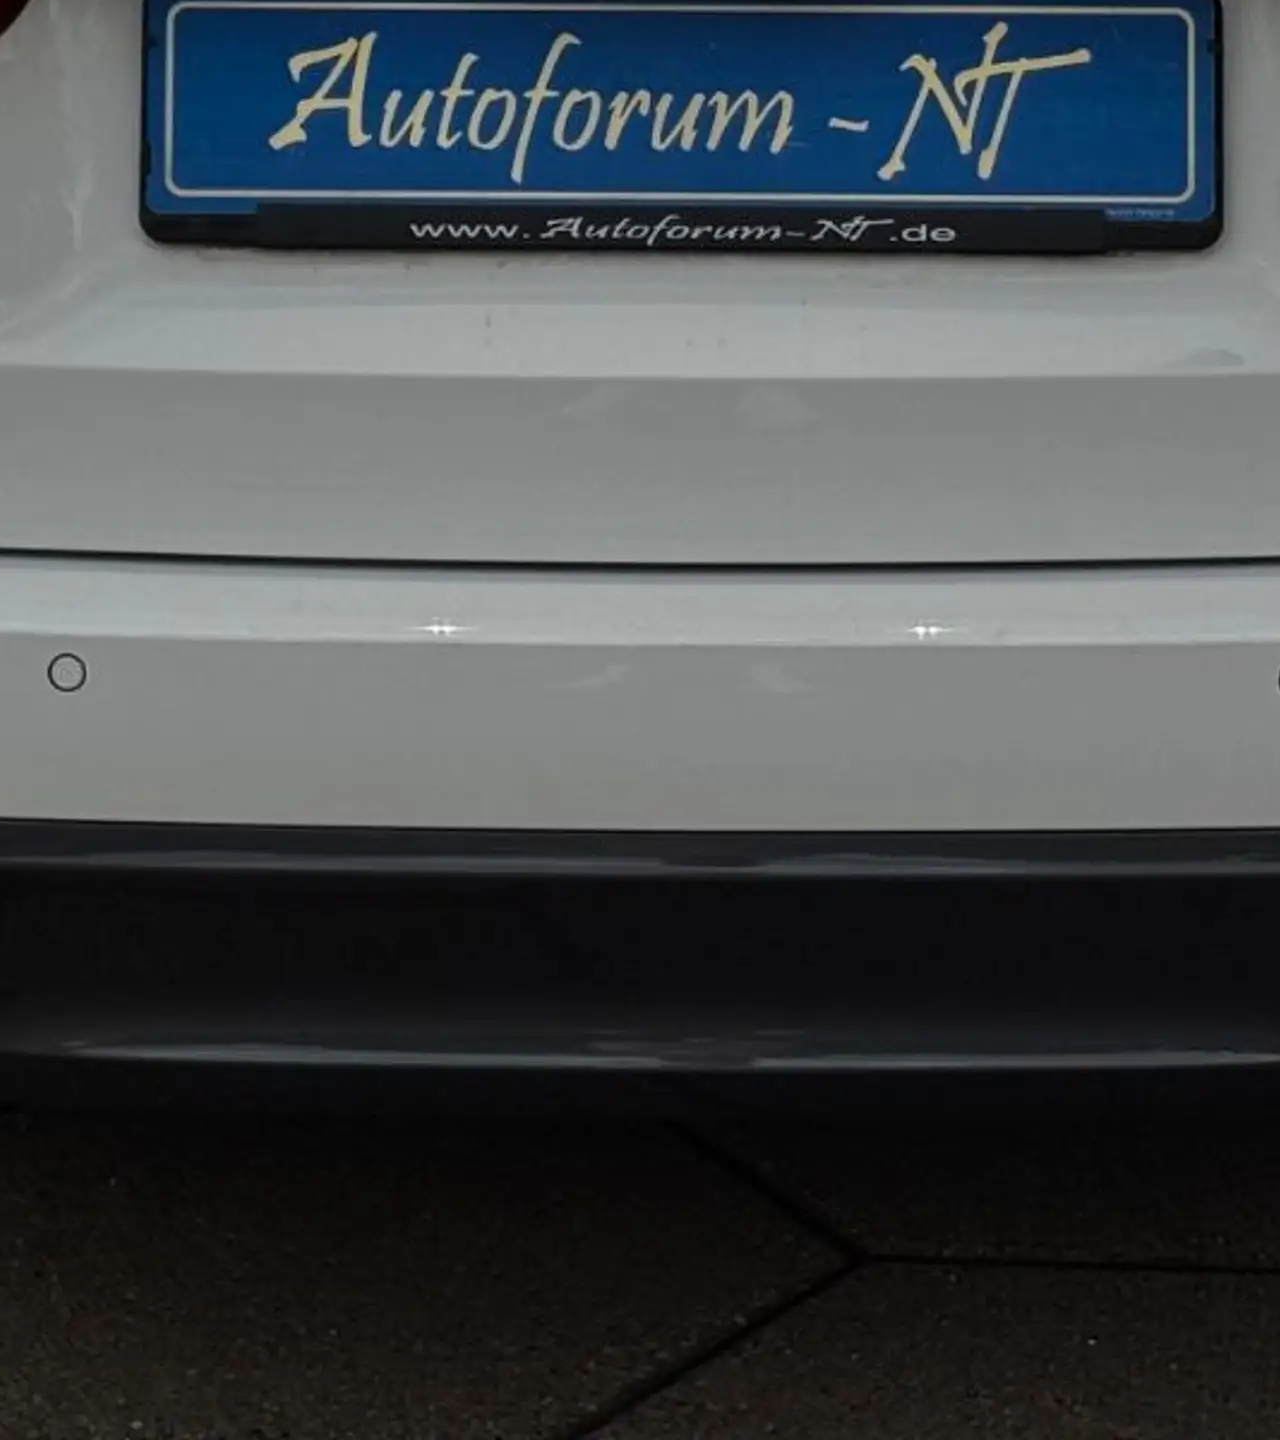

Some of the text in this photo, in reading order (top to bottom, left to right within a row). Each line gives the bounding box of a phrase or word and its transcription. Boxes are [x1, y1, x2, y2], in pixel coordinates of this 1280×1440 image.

[269, 20, 1092, 185] Autoforum - NT
[409, 214, 957, 247] www.Autoforum-NT.de
